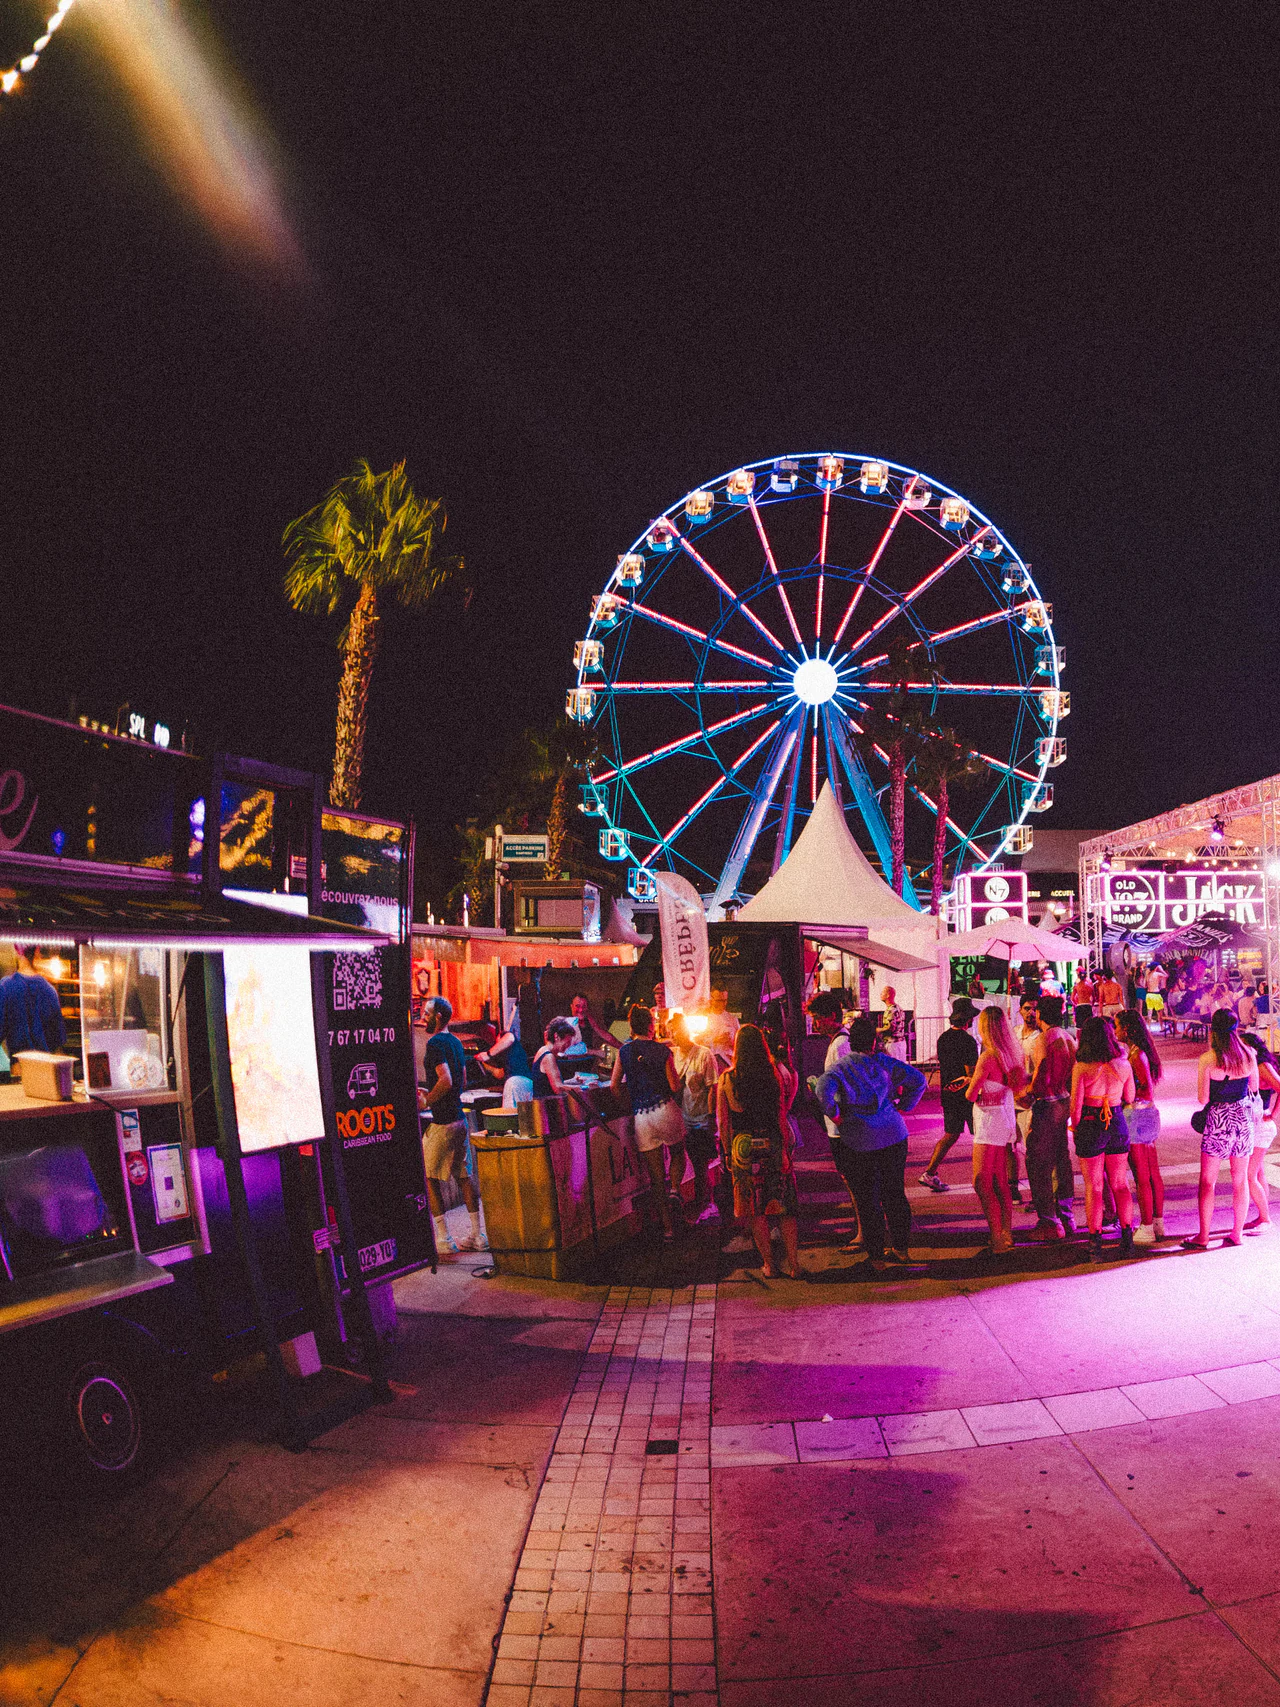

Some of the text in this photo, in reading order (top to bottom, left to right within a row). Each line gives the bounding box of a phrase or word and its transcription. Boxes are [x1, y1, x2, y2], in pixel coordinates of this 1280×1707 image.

[1115, 880, 1136, 890] OLD
[321, 888, 398, 906] écouvrez-nous
[1171, 876, 1260, 926] JACK
[1112, 914, 1143, 925] BRAND
[337, 1029, 350, 1046] 67
[353, 1029, 365, 1044] 17
[368, 1028, 381, 1043] 04
[383, 1027, 395, 1042] 70
[335, 1103, 396, 1139] ROOTS
[343, 1132, 392, 1149] CARIBBEAN FOOD
